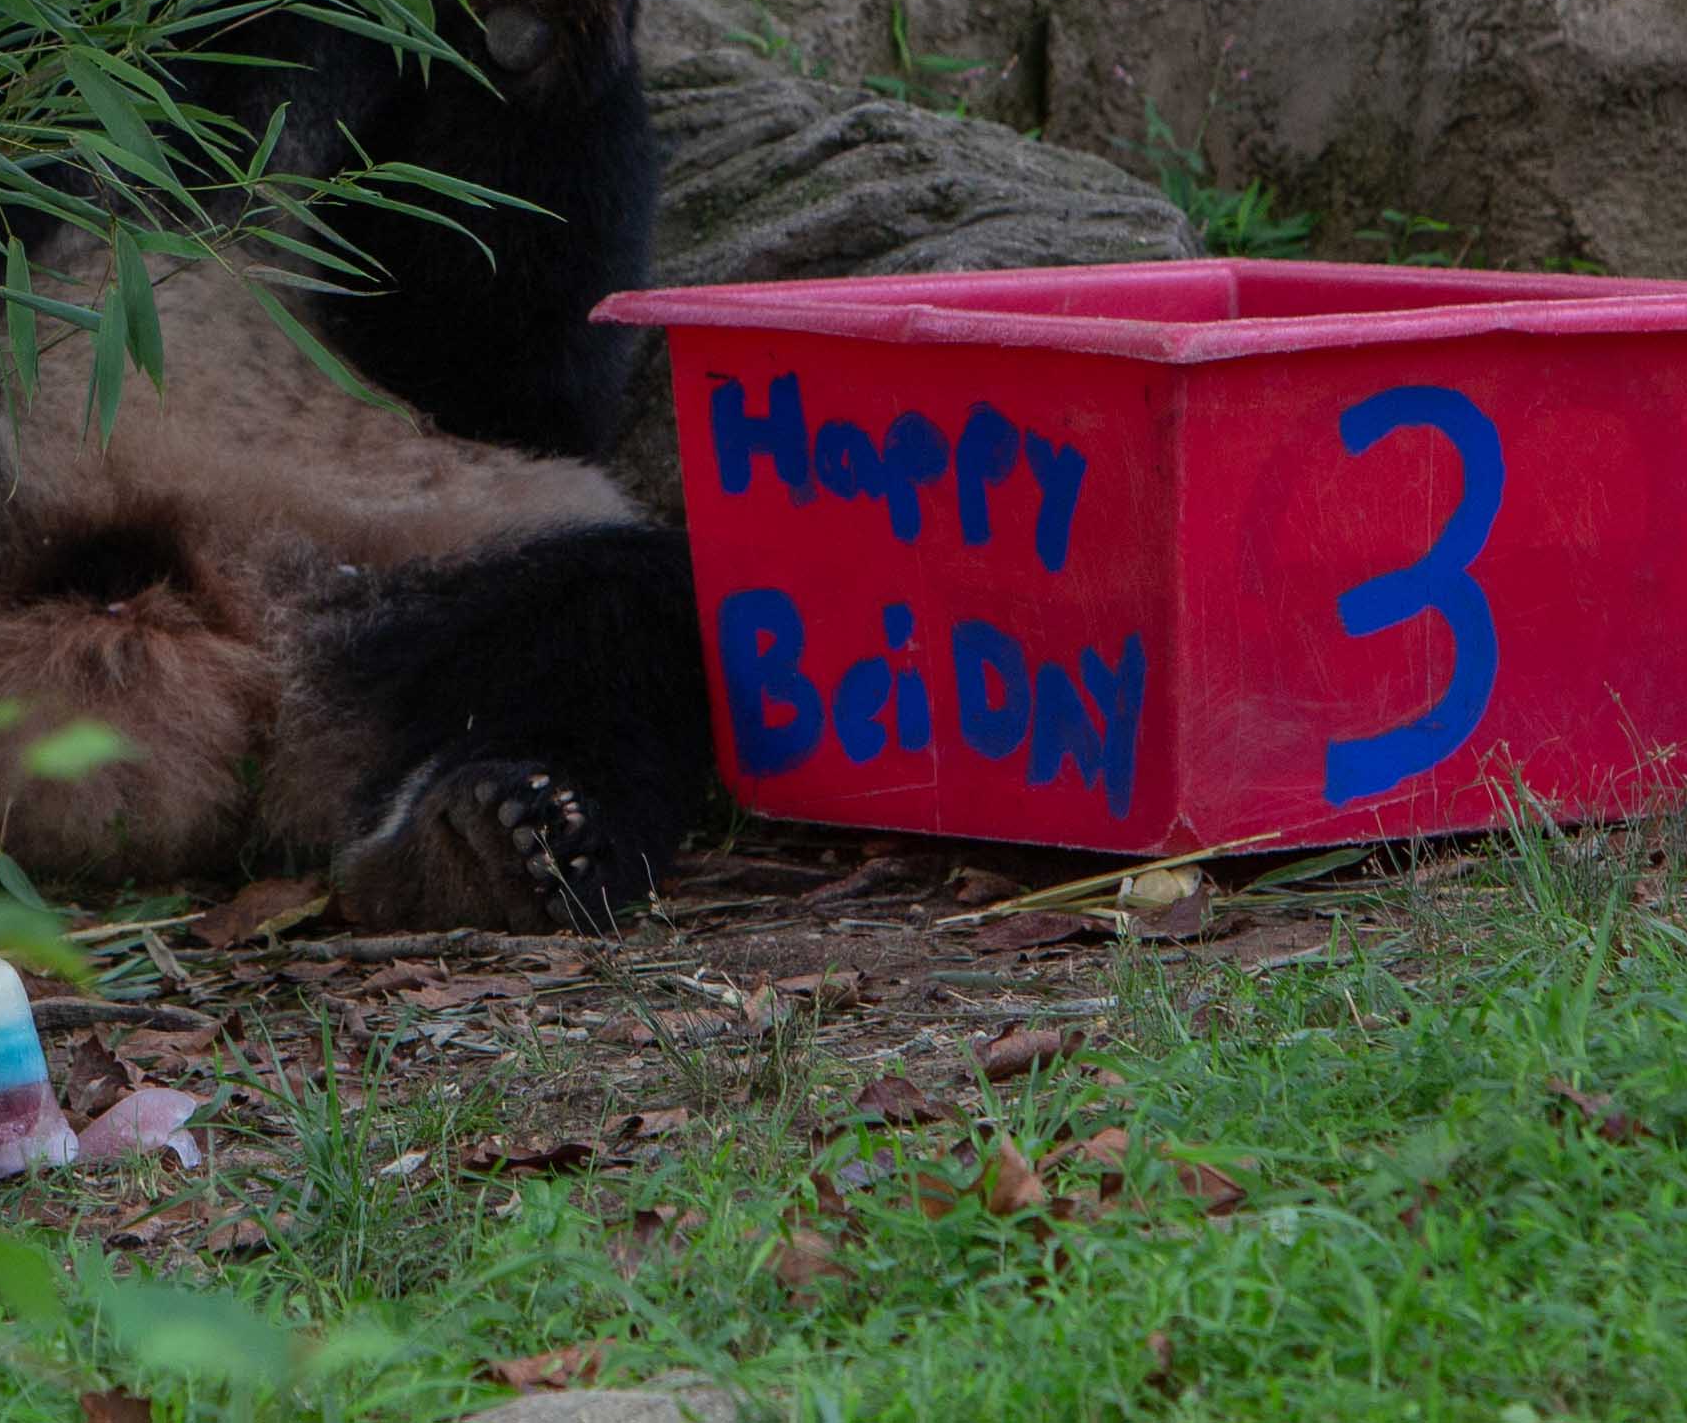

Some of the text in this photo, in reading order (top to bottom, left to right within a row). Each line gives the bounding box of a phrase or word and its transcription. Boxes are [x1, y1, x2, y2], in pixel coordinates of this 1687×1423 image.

[711, 373, 1087, 572] Happy
[718, 589, 932, 775] Bei
[1323, 385, 1506, 808] 3
